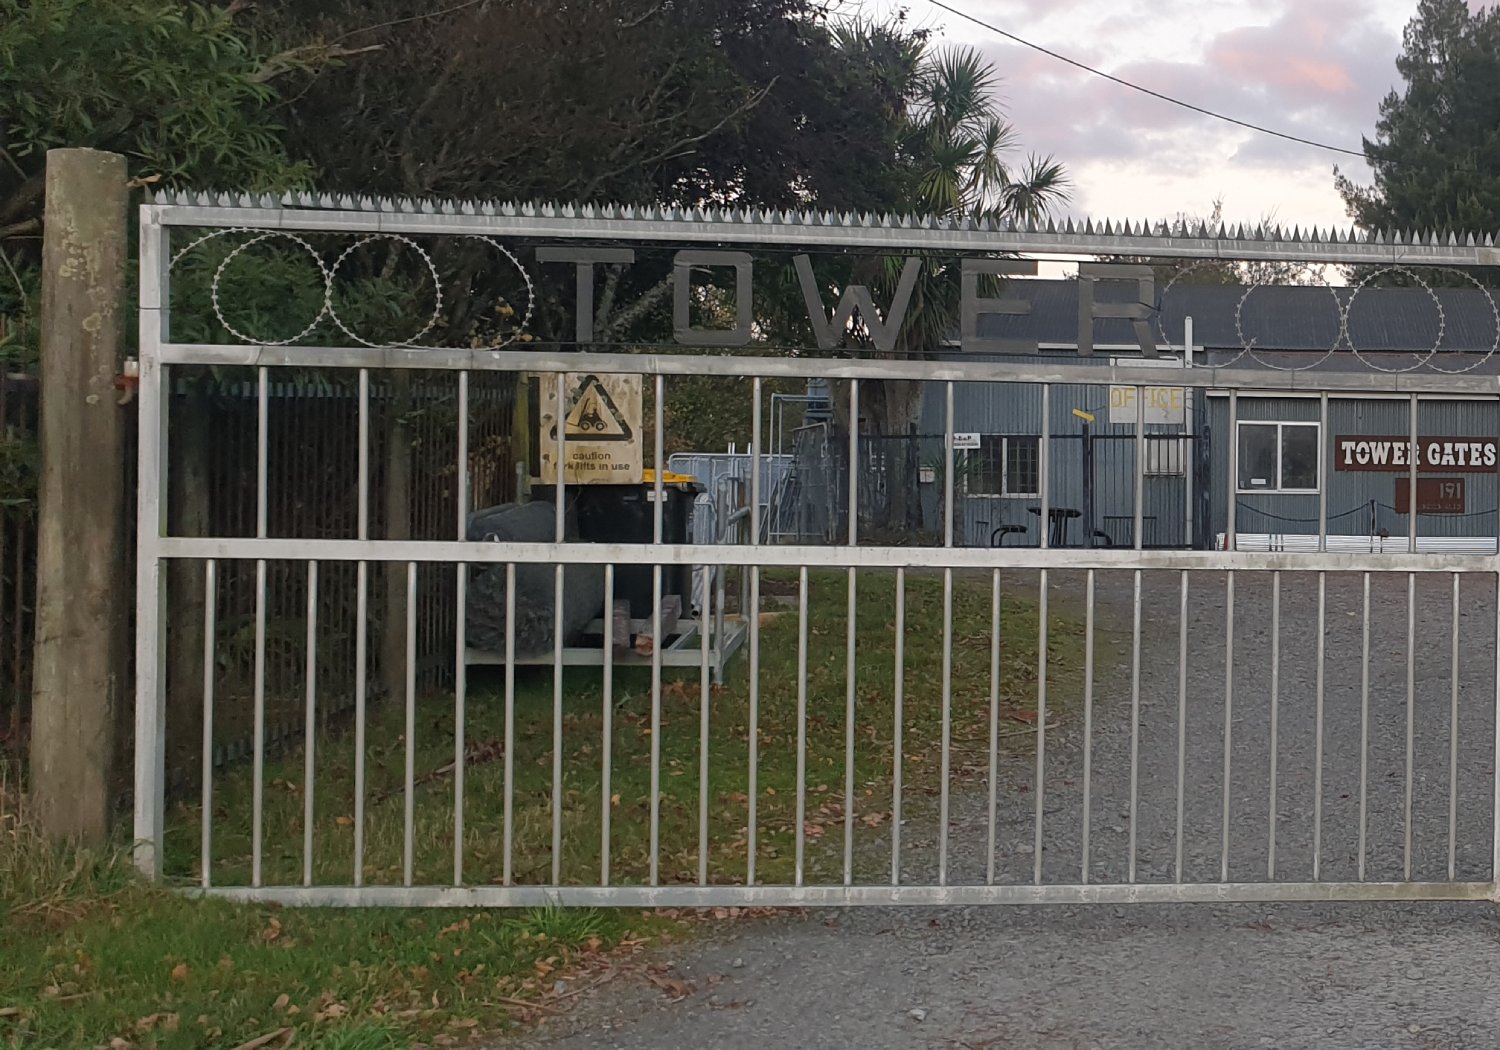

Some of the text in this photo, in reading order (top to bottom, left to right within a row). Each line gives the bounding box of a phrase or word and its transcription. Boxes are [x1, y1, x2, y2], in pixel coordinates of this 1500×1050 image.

[535, 247, 1160, 357] TOWER
[1111, 388, 1183, 409] OFICE
[572, 451, 611, 460] caution
[1427, 442, 1497, 466] GATES
[599, 462, 608, 471] in
[611, 463, 630, 471] use
[1440, 482, 1461, 499] 191
